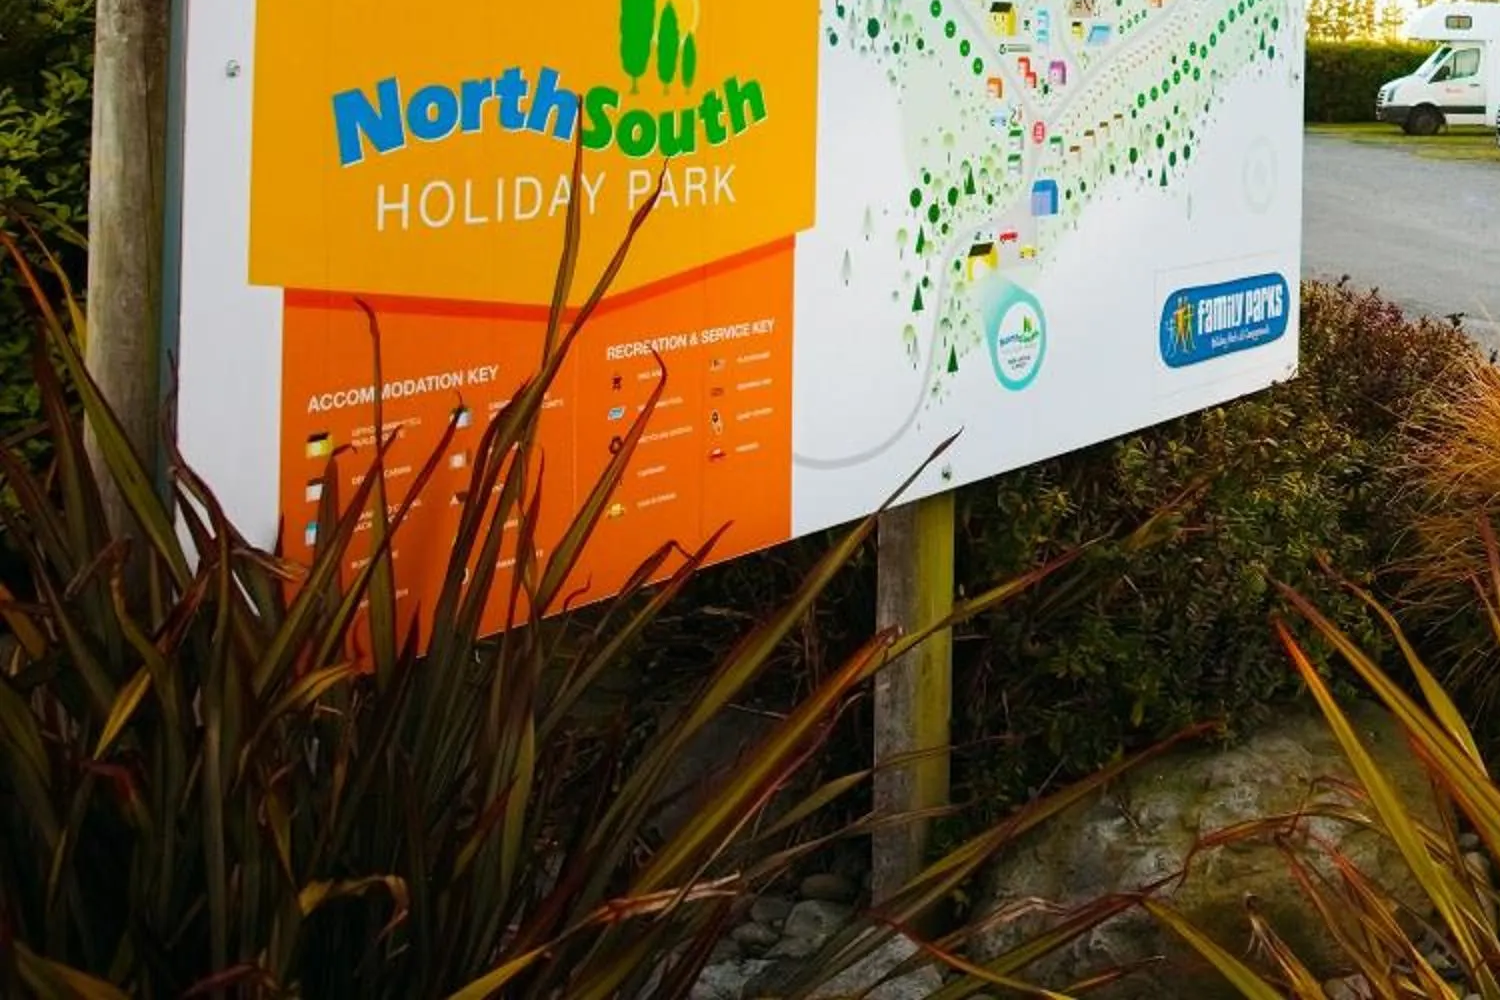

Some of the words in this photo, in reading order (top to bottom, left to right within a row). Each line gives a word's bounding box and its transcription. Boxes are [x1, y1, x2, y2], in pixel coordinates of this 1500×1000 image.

[376, 171, 607, 232] HOLIDAY
[627, 164, 737, 211] PARK
[606, 332, 688, 361] RECREATION
[700, 322, 750, 345] SERVICE
[750, 317, 776, 337] KEY
[467, 364, 499, 386] KEY
